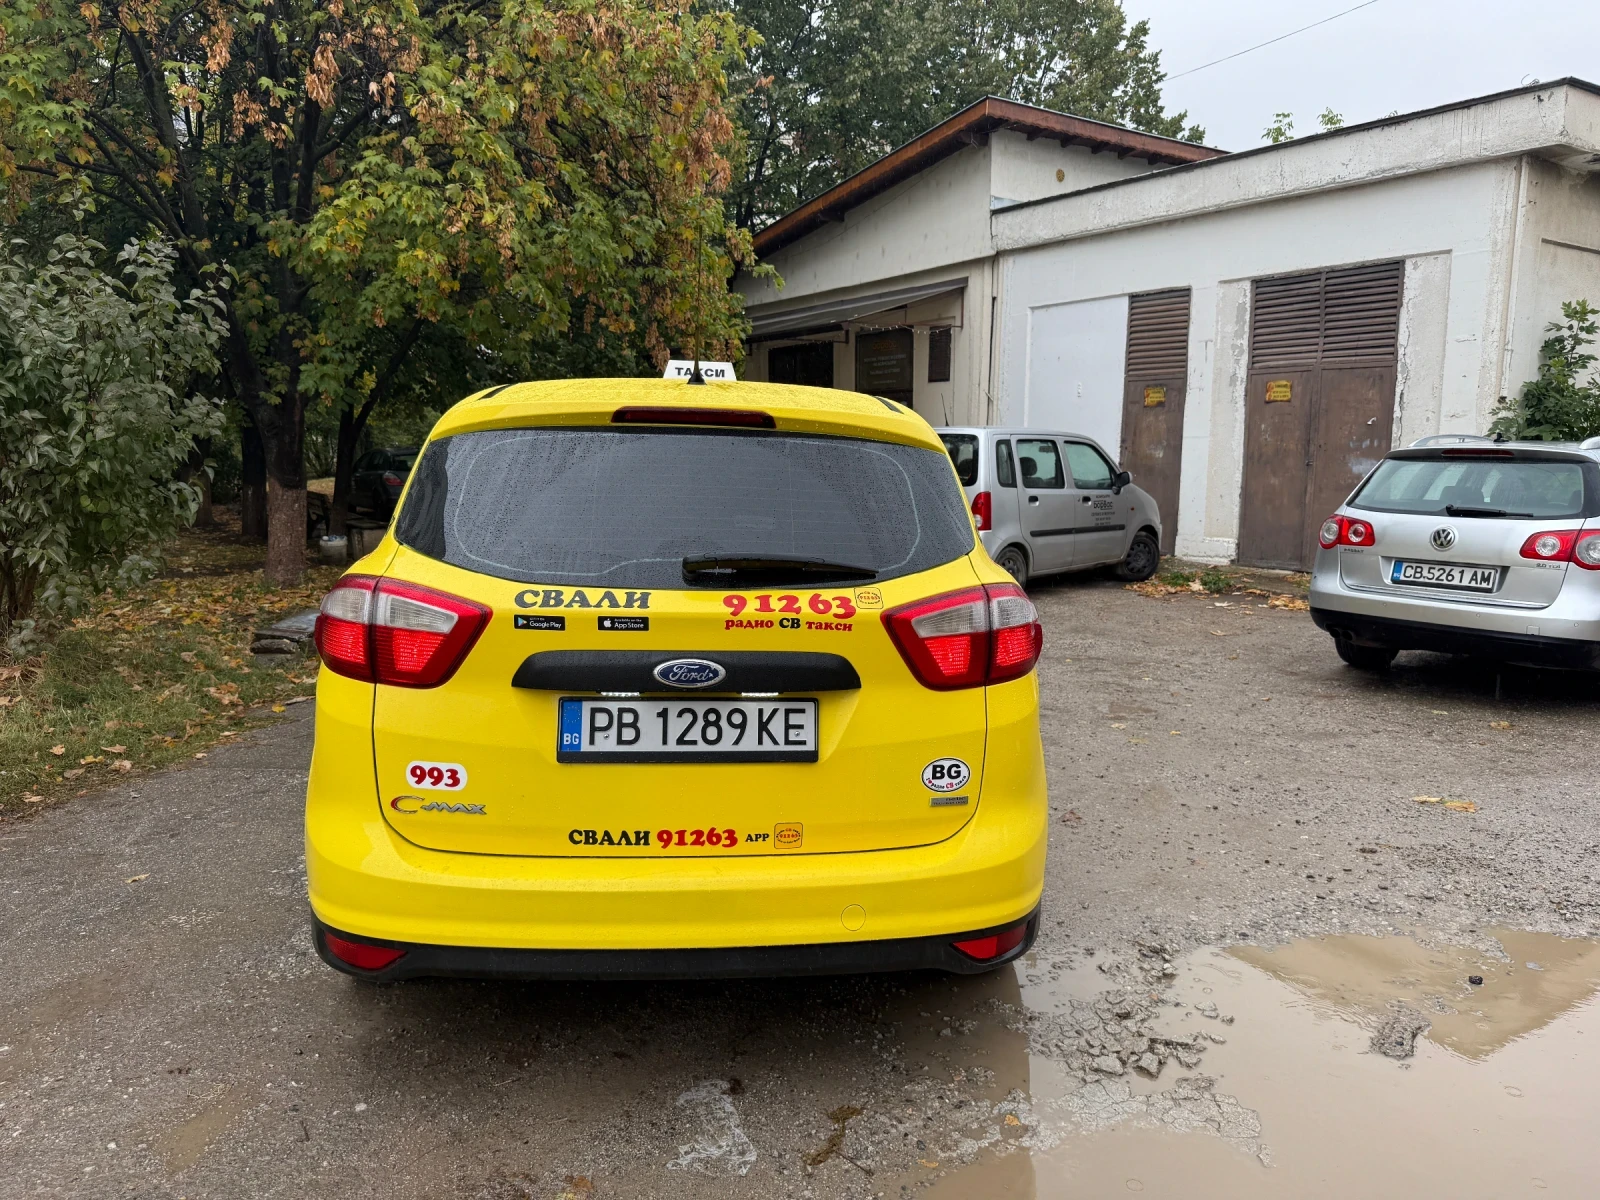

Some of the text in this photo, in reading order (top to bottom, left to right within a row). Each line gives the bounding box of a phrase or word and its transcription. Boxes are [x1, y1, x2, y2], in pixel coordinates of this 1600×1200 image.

[514, 589, 651, 609] СВАЛИ
[529, 620, 549, 628] Google
[724, 617, 853, 632] радио СВ такси
[669, 665, 709, 680] Ford
[589, 707, 807, 746] PB 1289 KE
[563, 733, 579, 745] BG
[410, 765, 461, 787] 993
[932, 764, 962, 780] BG
[568, 827, 770, 849] СВАЛИ 91263 APP
